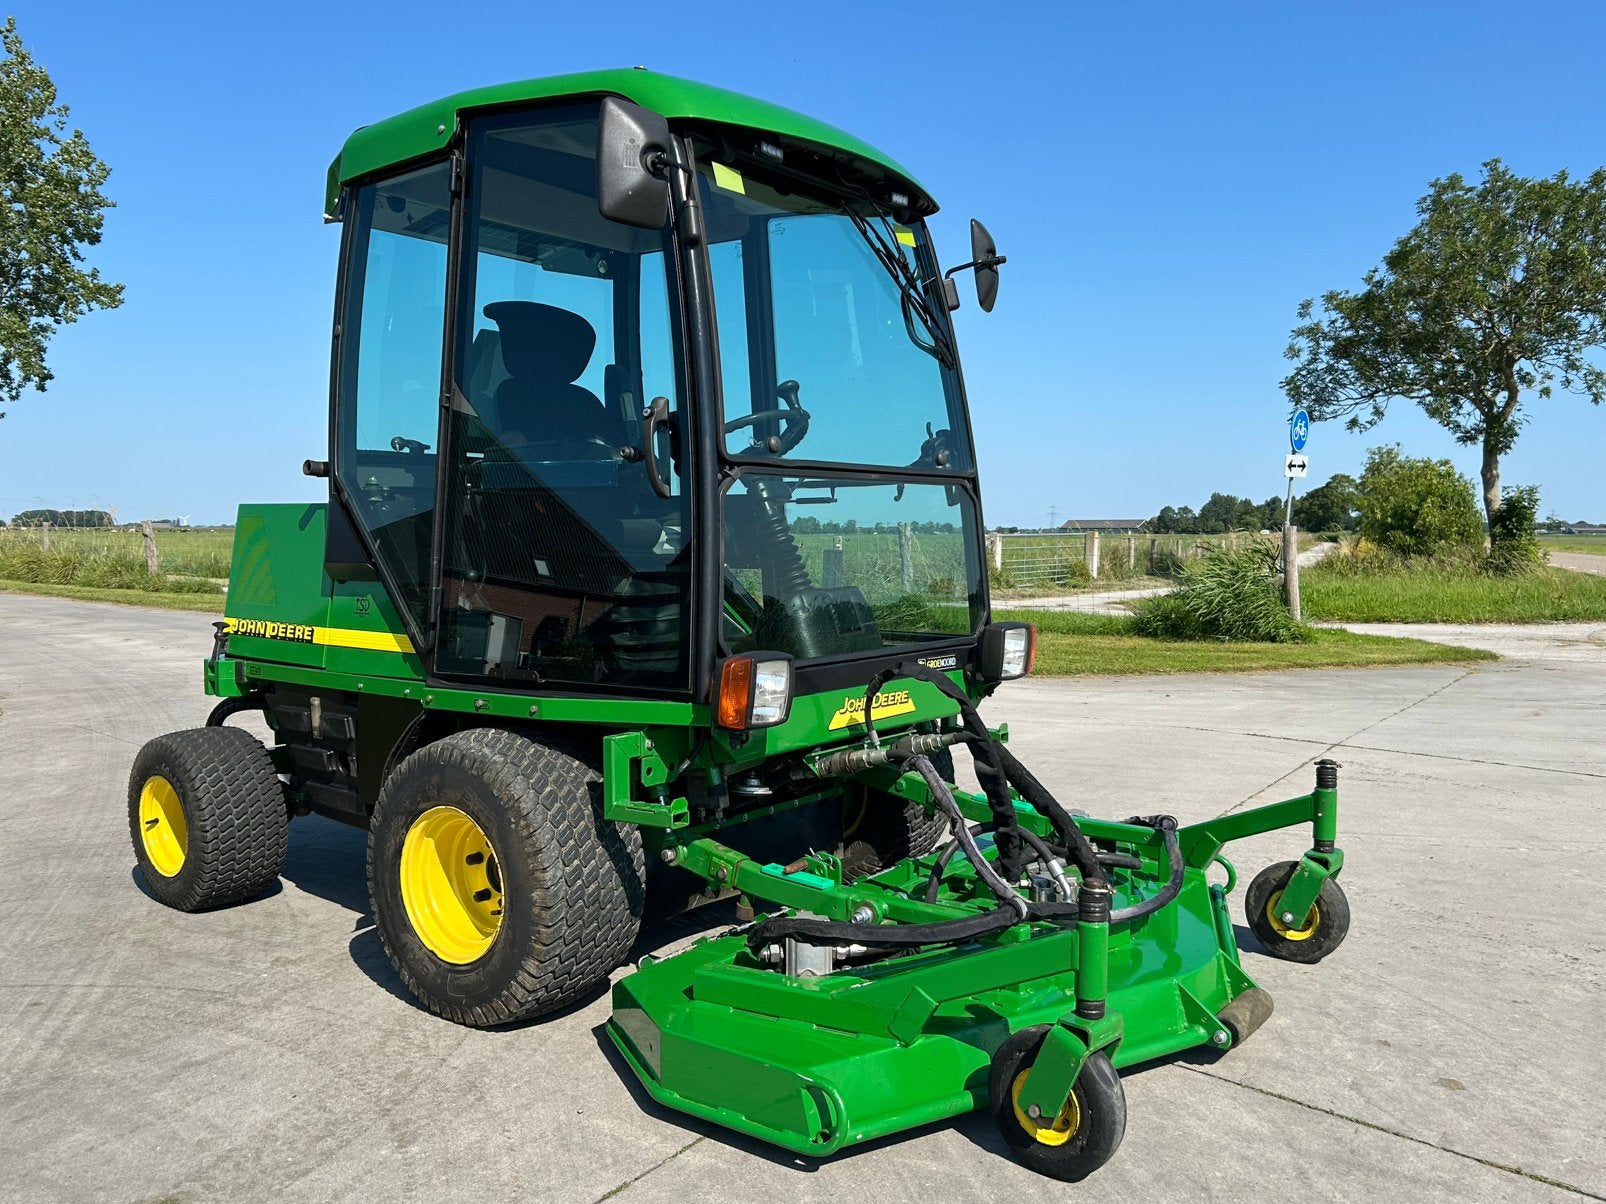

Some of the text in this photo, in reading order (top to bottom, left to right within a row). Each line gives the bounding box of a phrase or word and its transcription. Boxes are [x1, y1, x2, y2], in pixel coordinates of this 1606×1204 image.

[231, 618, 312, 640] JOHN DEERE
[872, 690, 909, 709] DEERE
